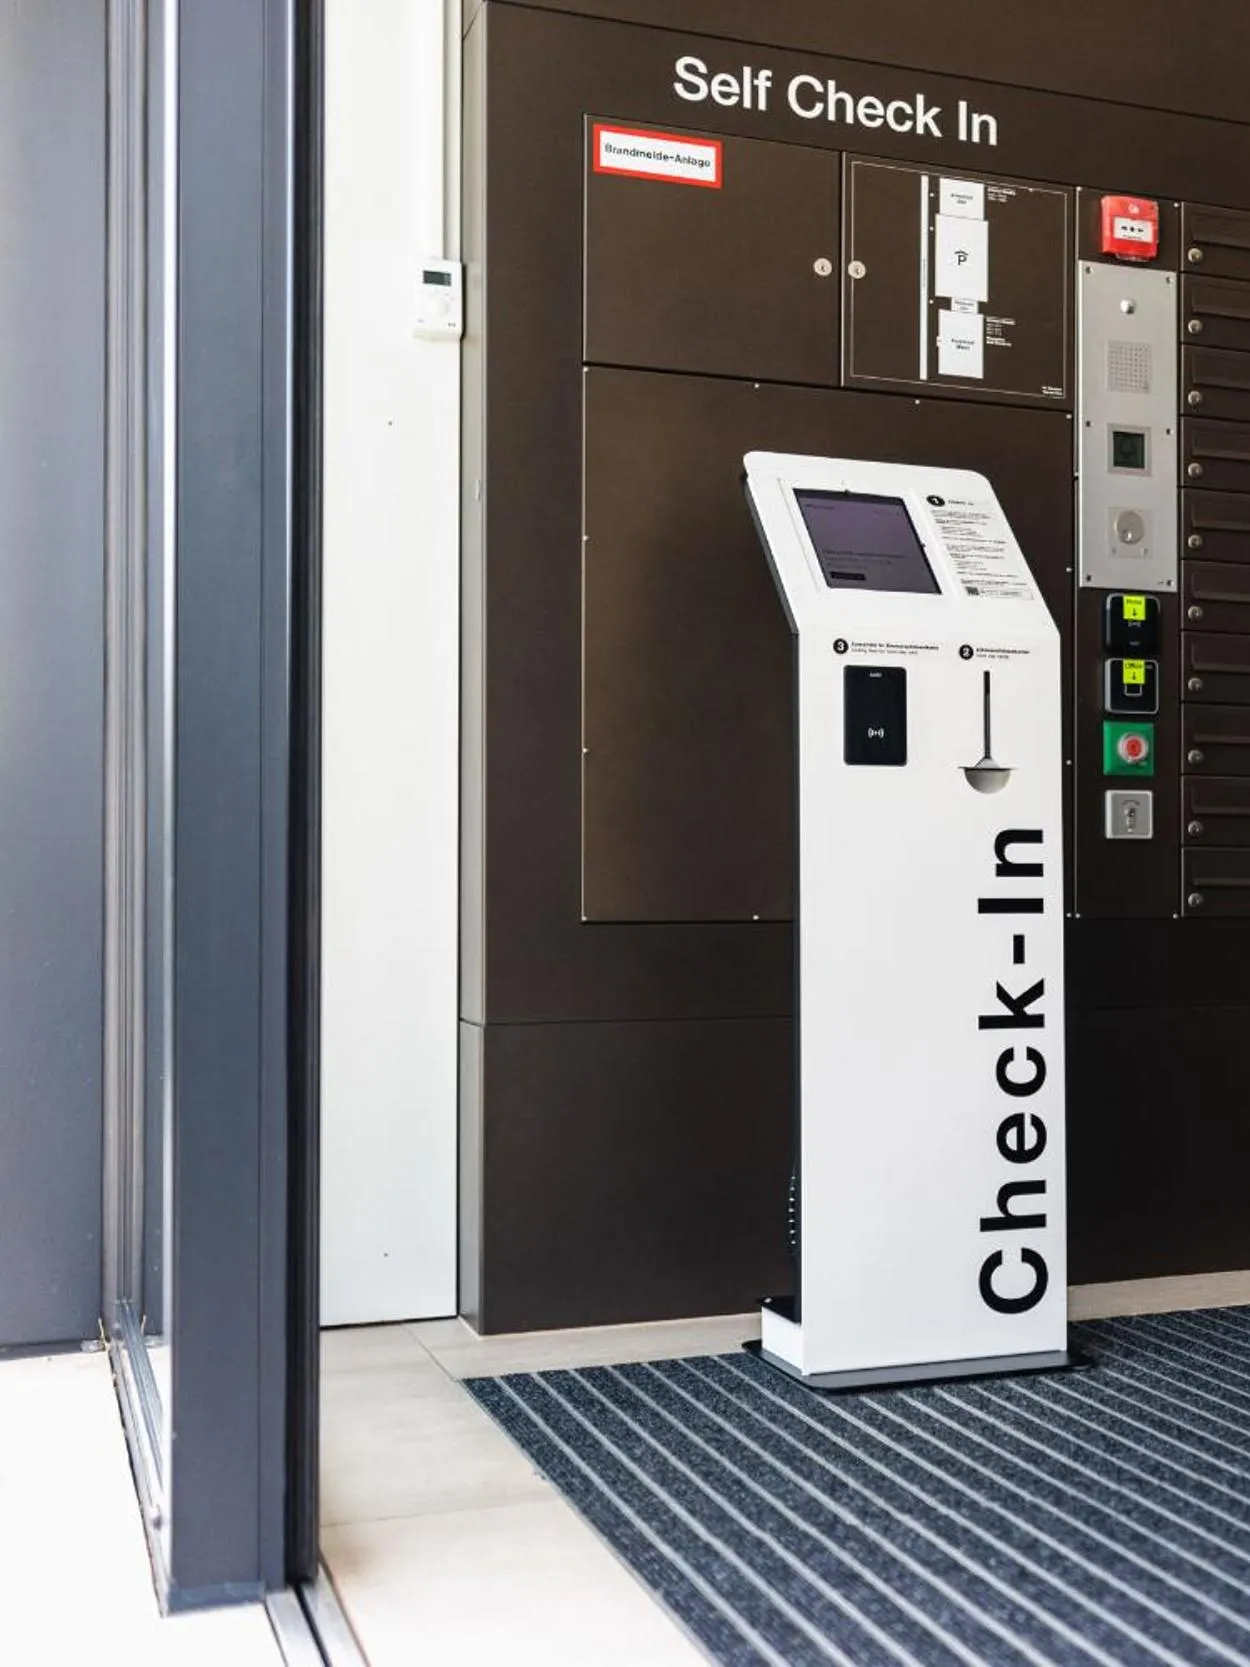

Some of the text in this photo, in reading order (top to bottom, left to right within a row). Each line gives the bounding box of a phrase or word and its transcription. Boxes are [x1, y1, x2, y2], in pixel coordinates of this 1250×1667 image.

[673, 55, 998, 147] Self Check In
[977, 828, 1049, 1315] Check-In
